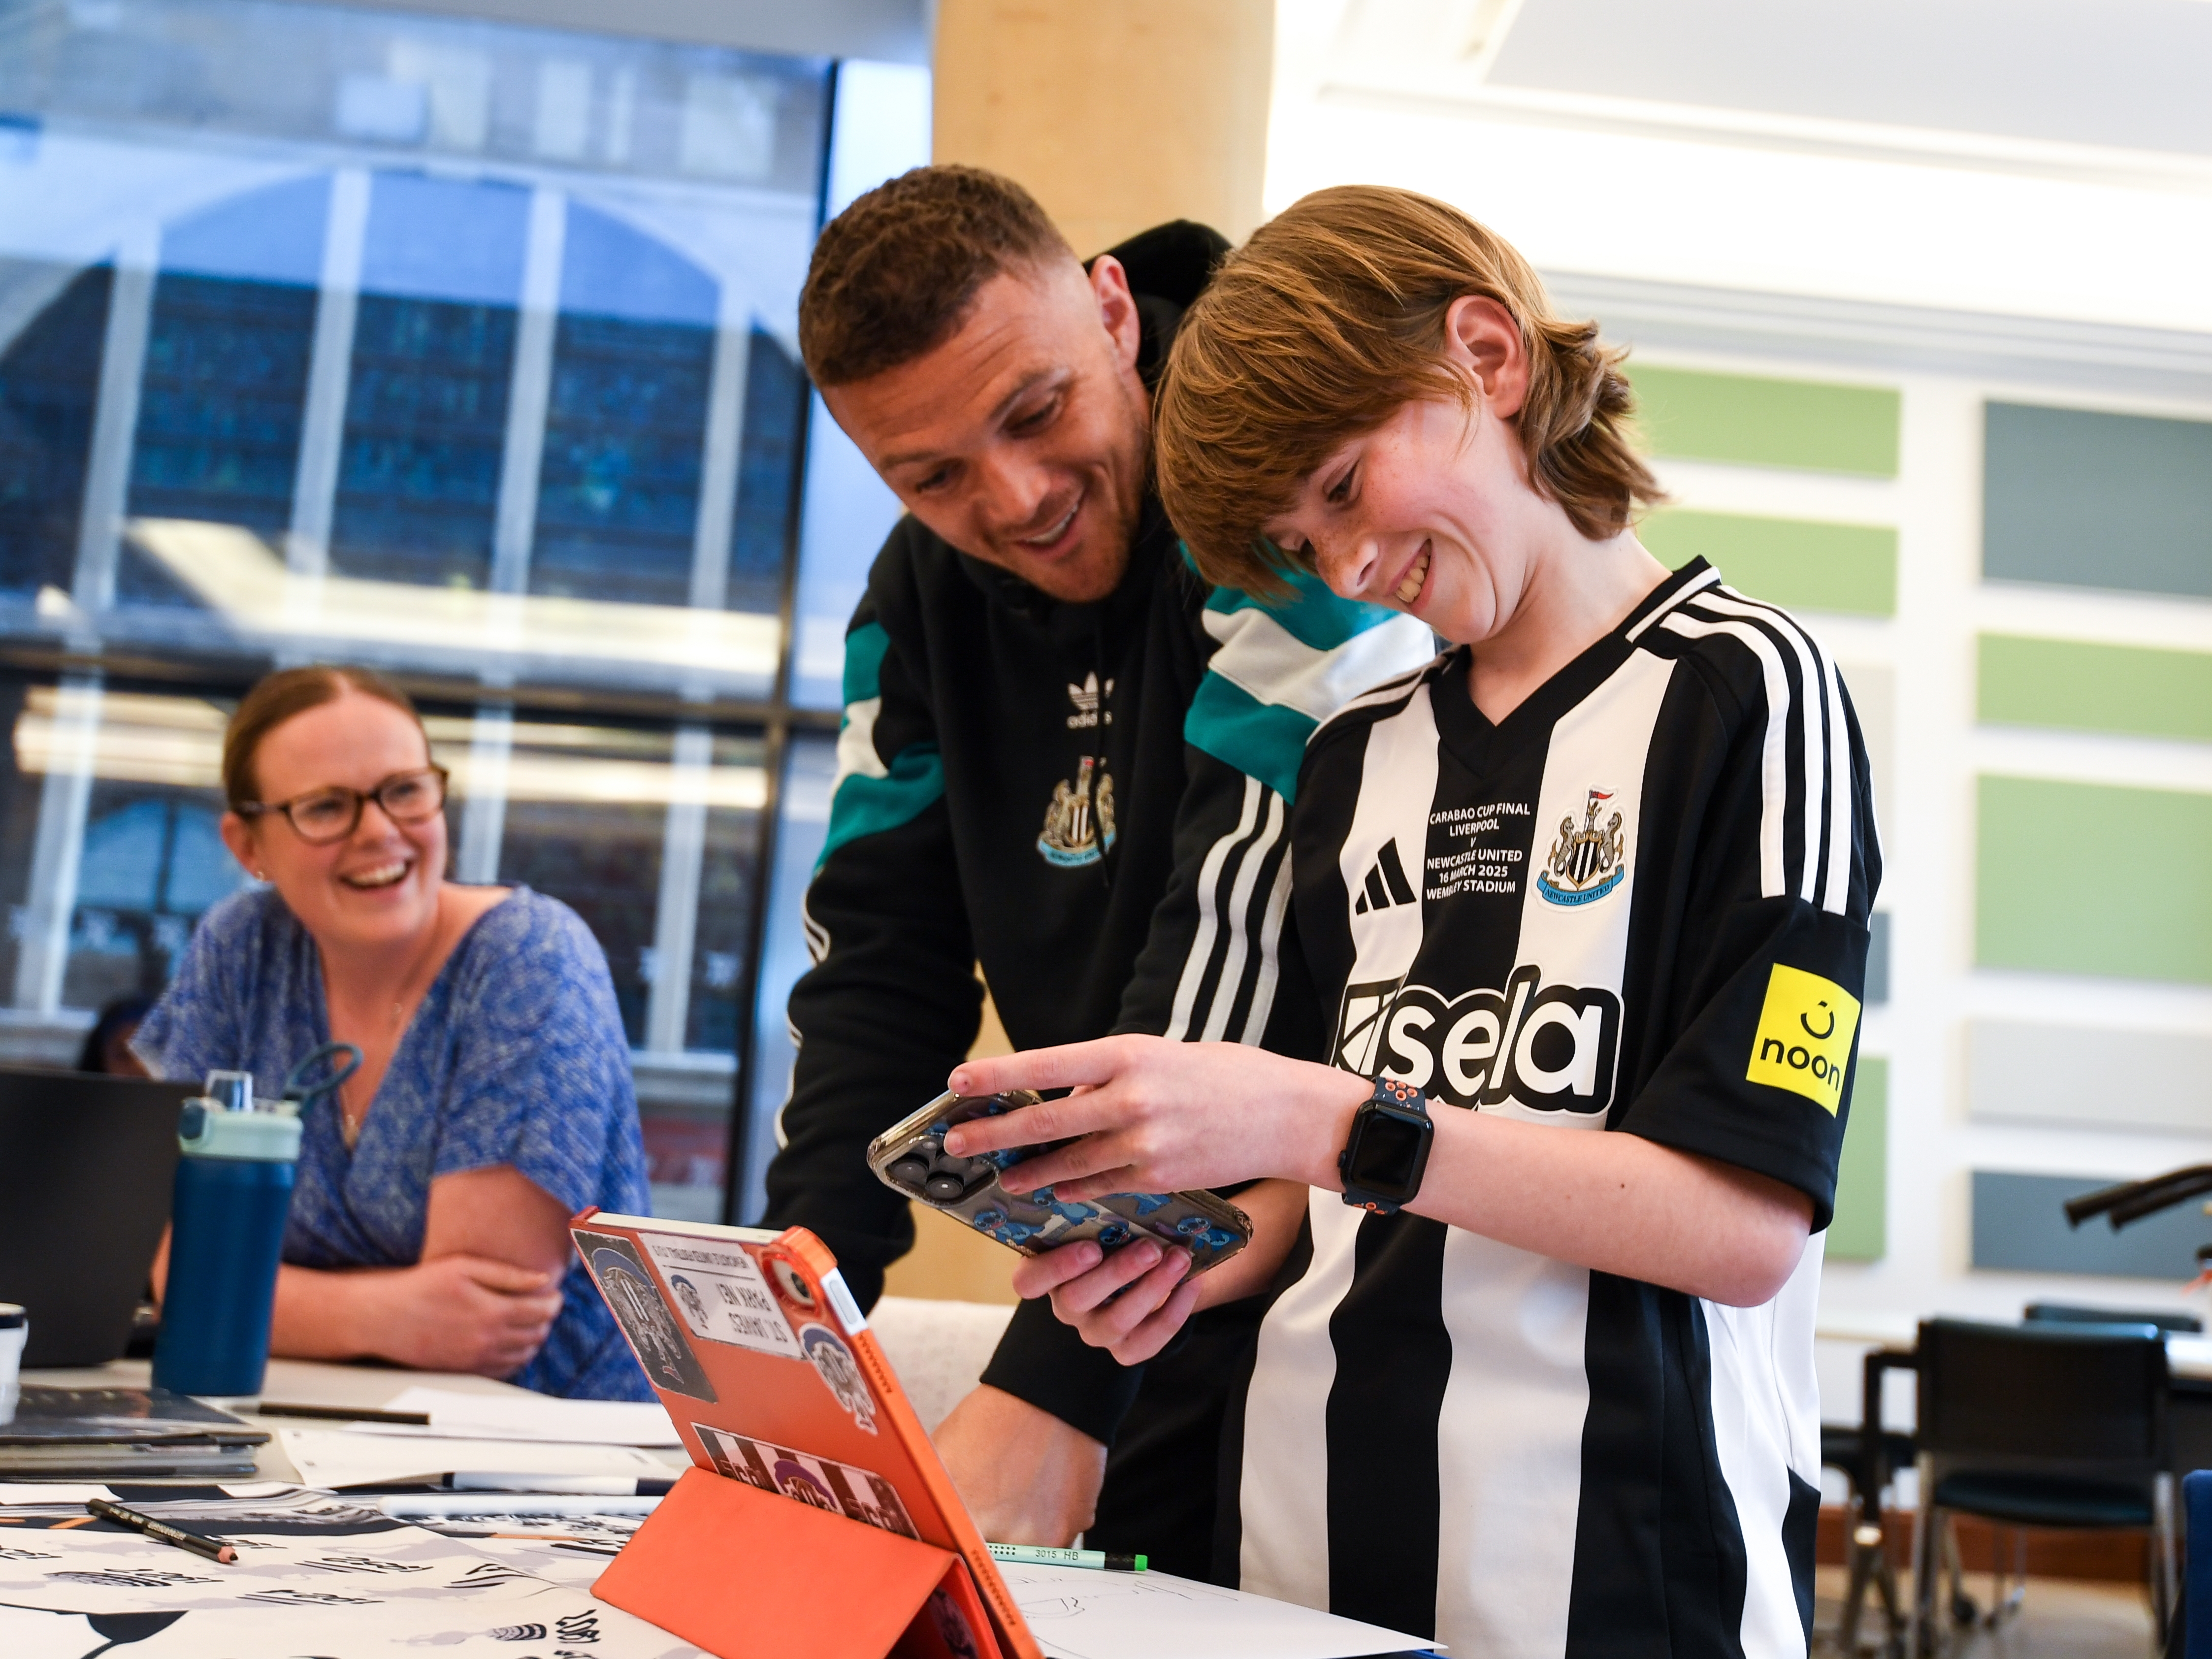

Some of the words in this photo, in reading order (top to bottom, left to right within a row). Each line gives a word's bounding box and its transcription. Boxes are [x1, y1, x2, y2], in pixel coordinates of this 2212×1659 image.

[1067, 710, 1112, 728] adids
[1430, 808, 1475, 825] CARABAO
[1477, 804, 1495, 818] CUP
[1496, 802, 1530, 815] FINAL
[1450, 818, 1499, 837] LIVERPOOL
[1427, 849, 1477, 870] NEWCASTLE
[1478, 848, 1523, 862] UNITED
[1439, 872, 1449, 884] 16
[1450, 864, 1476, 882] MARCH
[1478, 865, 1508, 878] 2025
[1463, 879, 1516, 893] STADIUM
[1545, 888, 1583, 903] NEWCASTLE
[1583, 884, 1610, 901] UNITED
[1379, 981, 1602, 1096] sela
[1760, 1038, 1840, 1092] noon
[736, 1285, 772, 1311] PARK
[1035, 1549, 1057, 1559] 3015
[1064, 1551, 1078, 1561] HB
